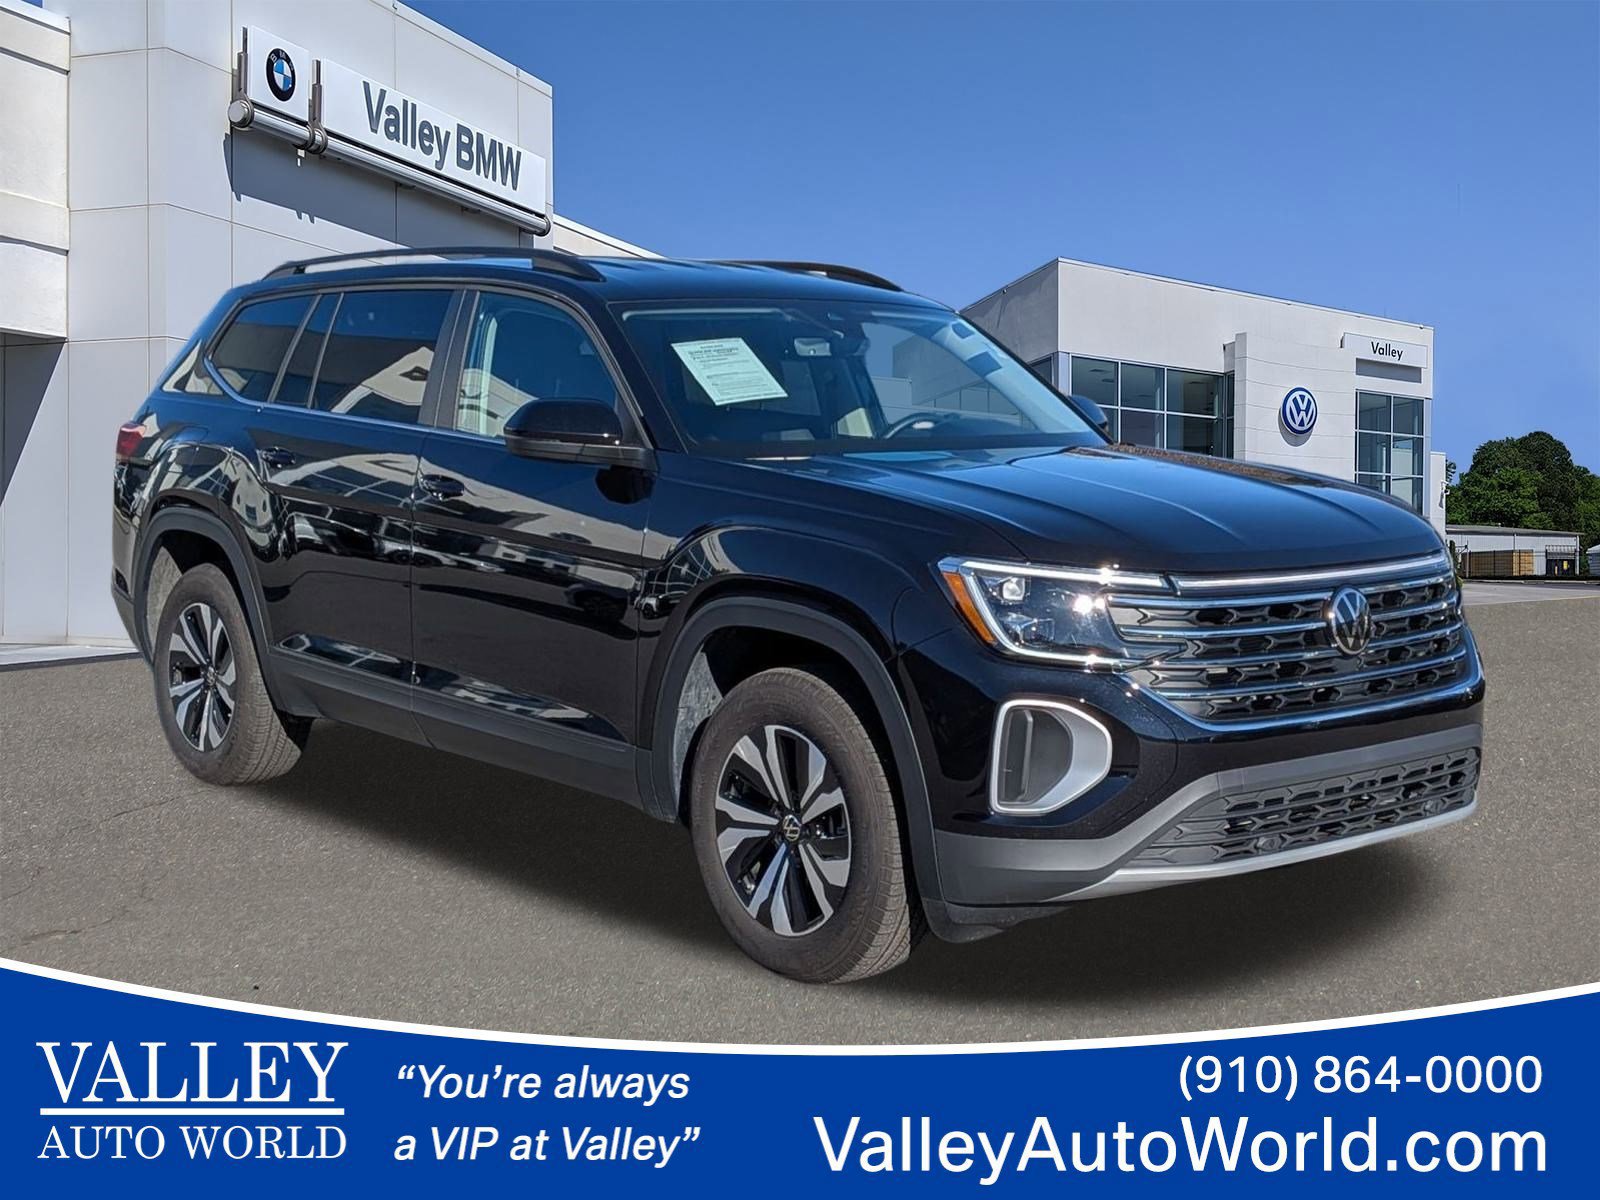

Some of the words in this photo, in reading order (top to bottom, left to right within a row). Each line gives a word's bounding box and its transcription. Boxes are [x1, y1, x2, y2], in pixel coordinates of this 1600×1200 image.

[361, 80, 451, 170] Valley
[456, 122, 522, 191] BMW
[1371, 341, 1404, 361] Valley
